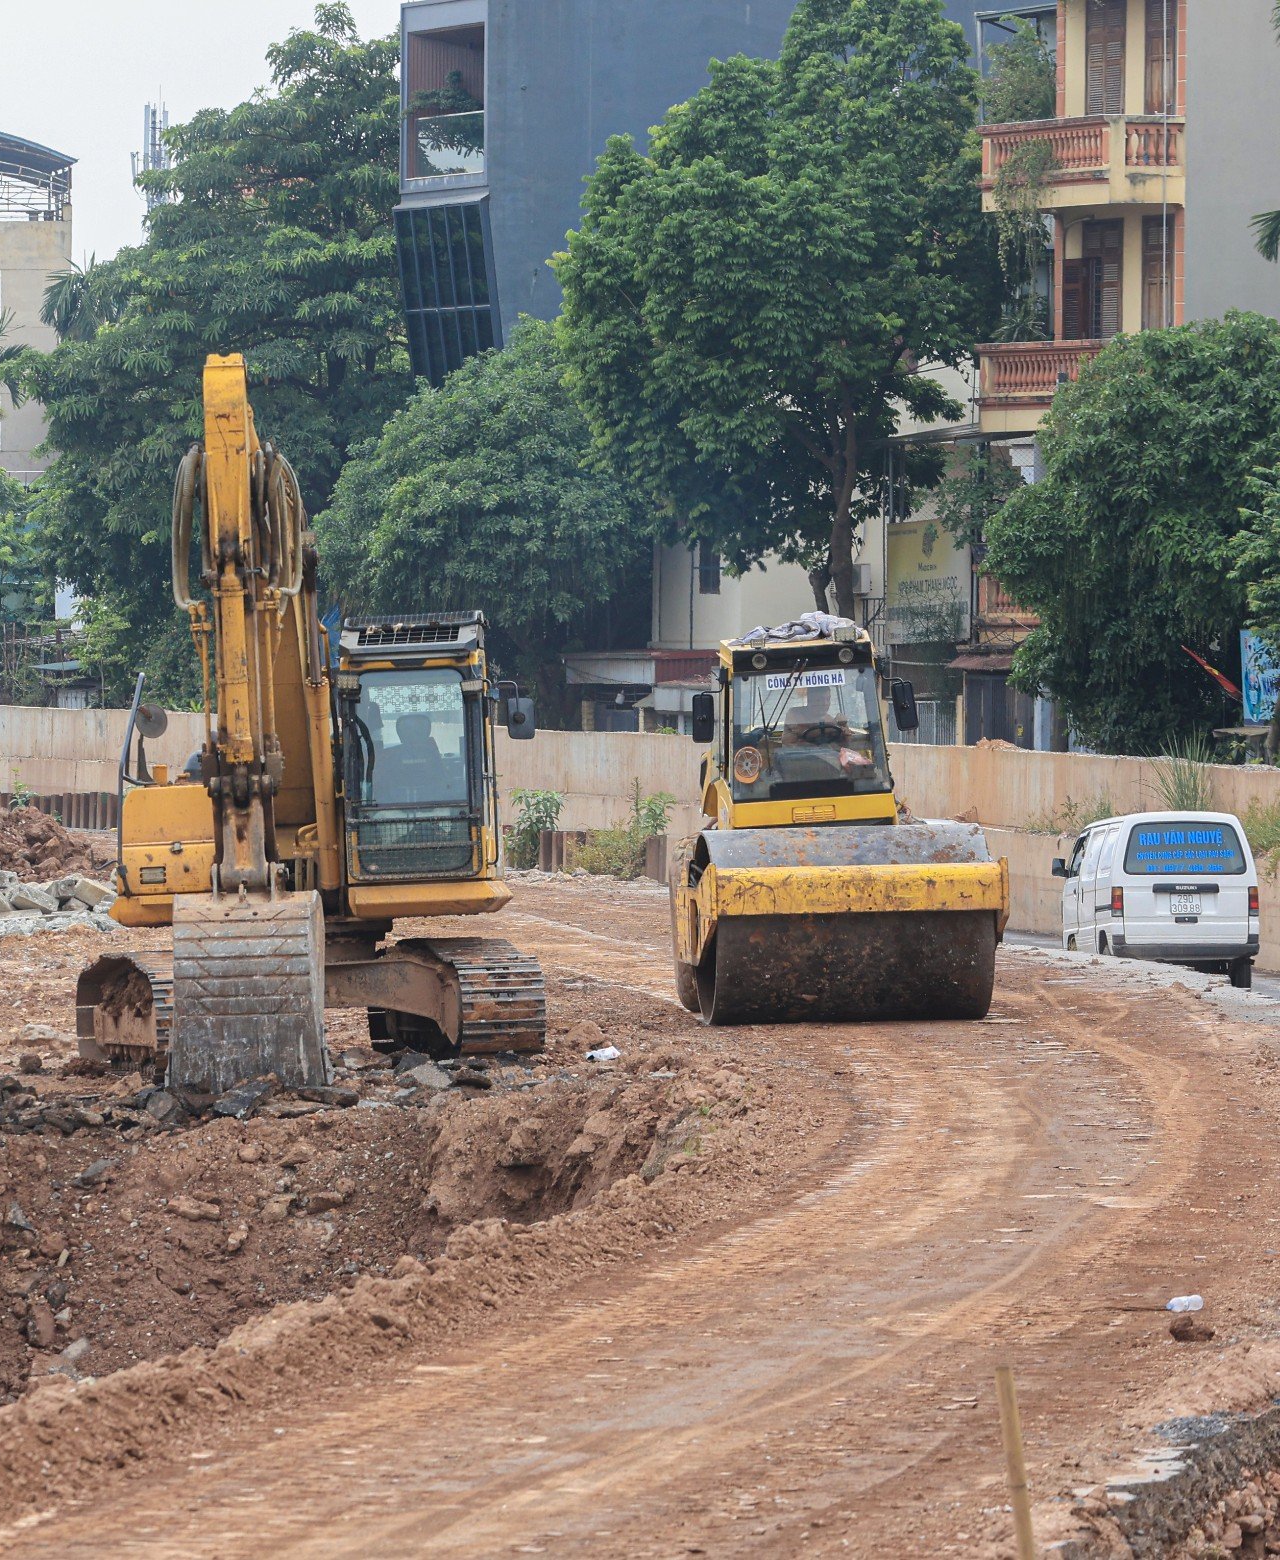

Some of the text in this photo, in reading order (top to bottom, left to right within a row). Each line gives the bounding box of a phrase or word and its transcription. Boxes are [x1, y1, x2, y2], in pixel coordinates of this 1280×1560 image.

[1139, 832, 1160, 846] RAU
[1163, 829, 1185, 845] VĂN
[1171, 903, 1201, 913] 309.88
